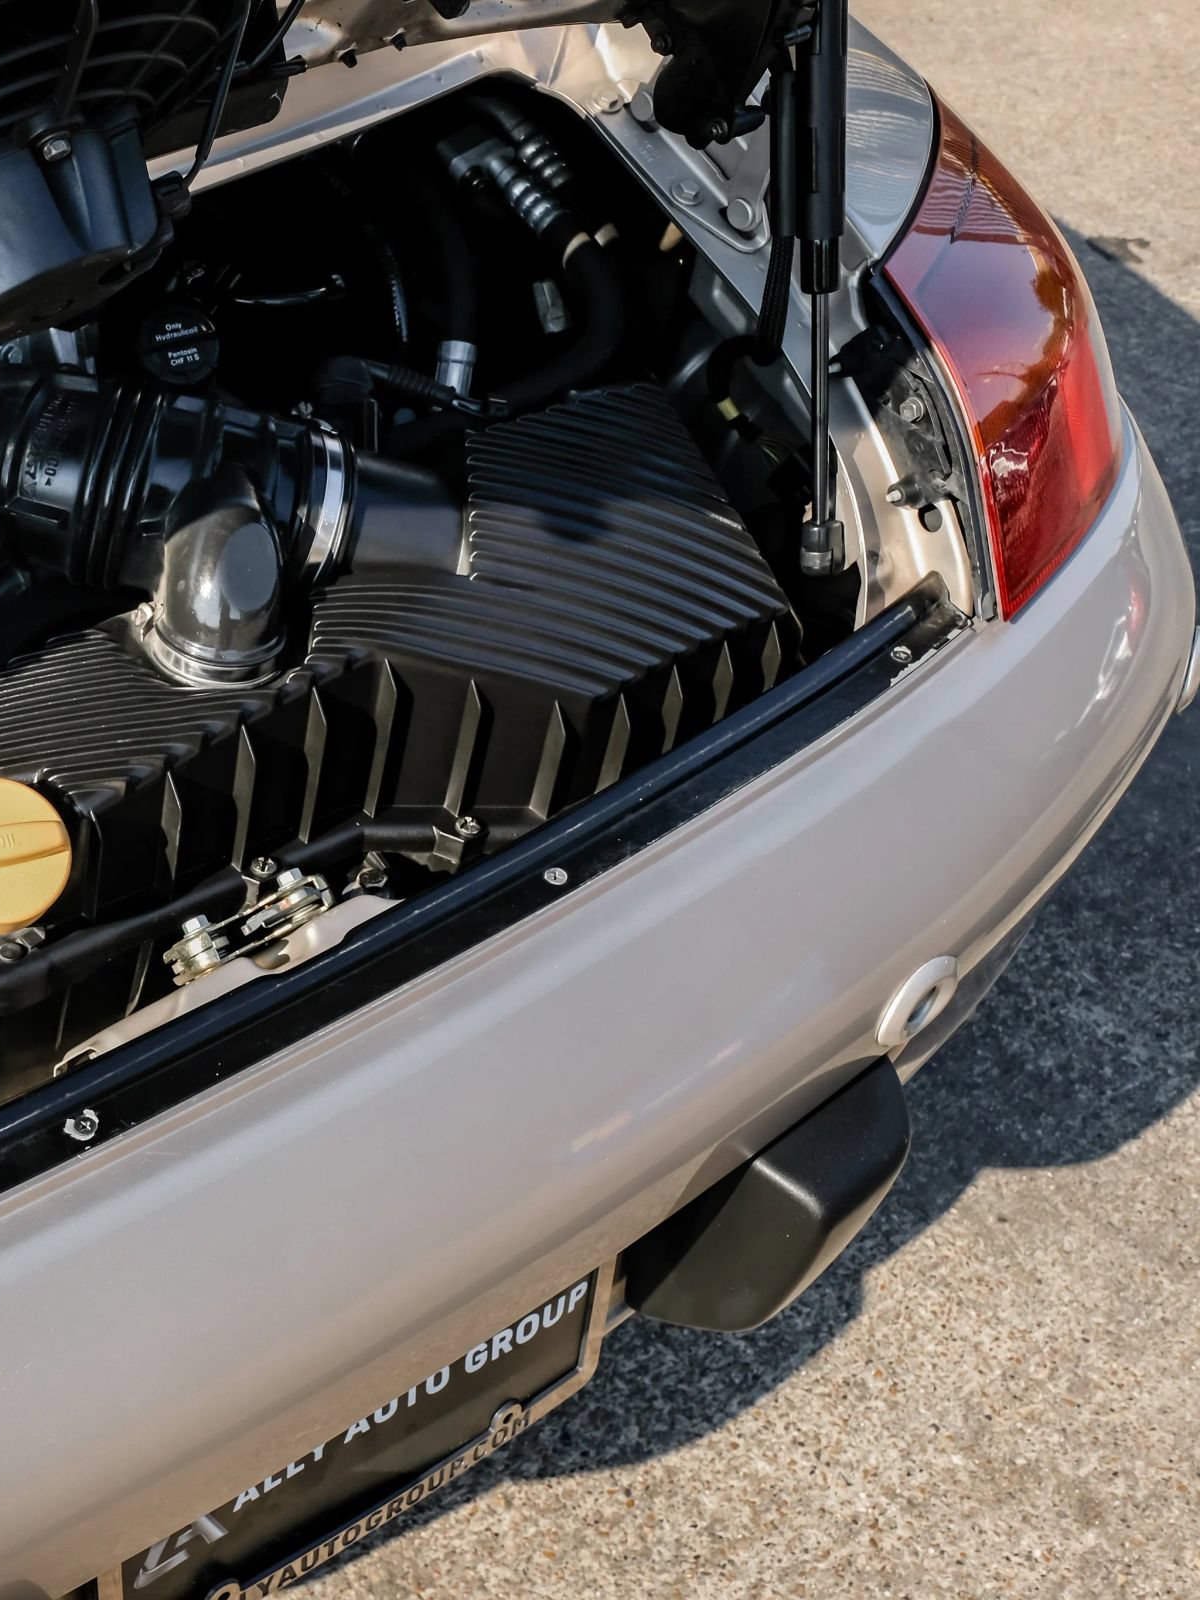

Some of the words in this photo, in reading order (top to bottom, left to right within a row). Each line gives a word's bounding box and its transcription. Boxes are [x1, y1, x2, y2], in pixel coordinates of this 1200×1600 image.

[166, 322, 182, 331] Only
[155, 326, 198, 342] Hydraulicoil
[168, 347, 197, 358] Pentosin
[171, 358, 184, 366] CHF
[465, 1281, 588, 1373] GROUP
